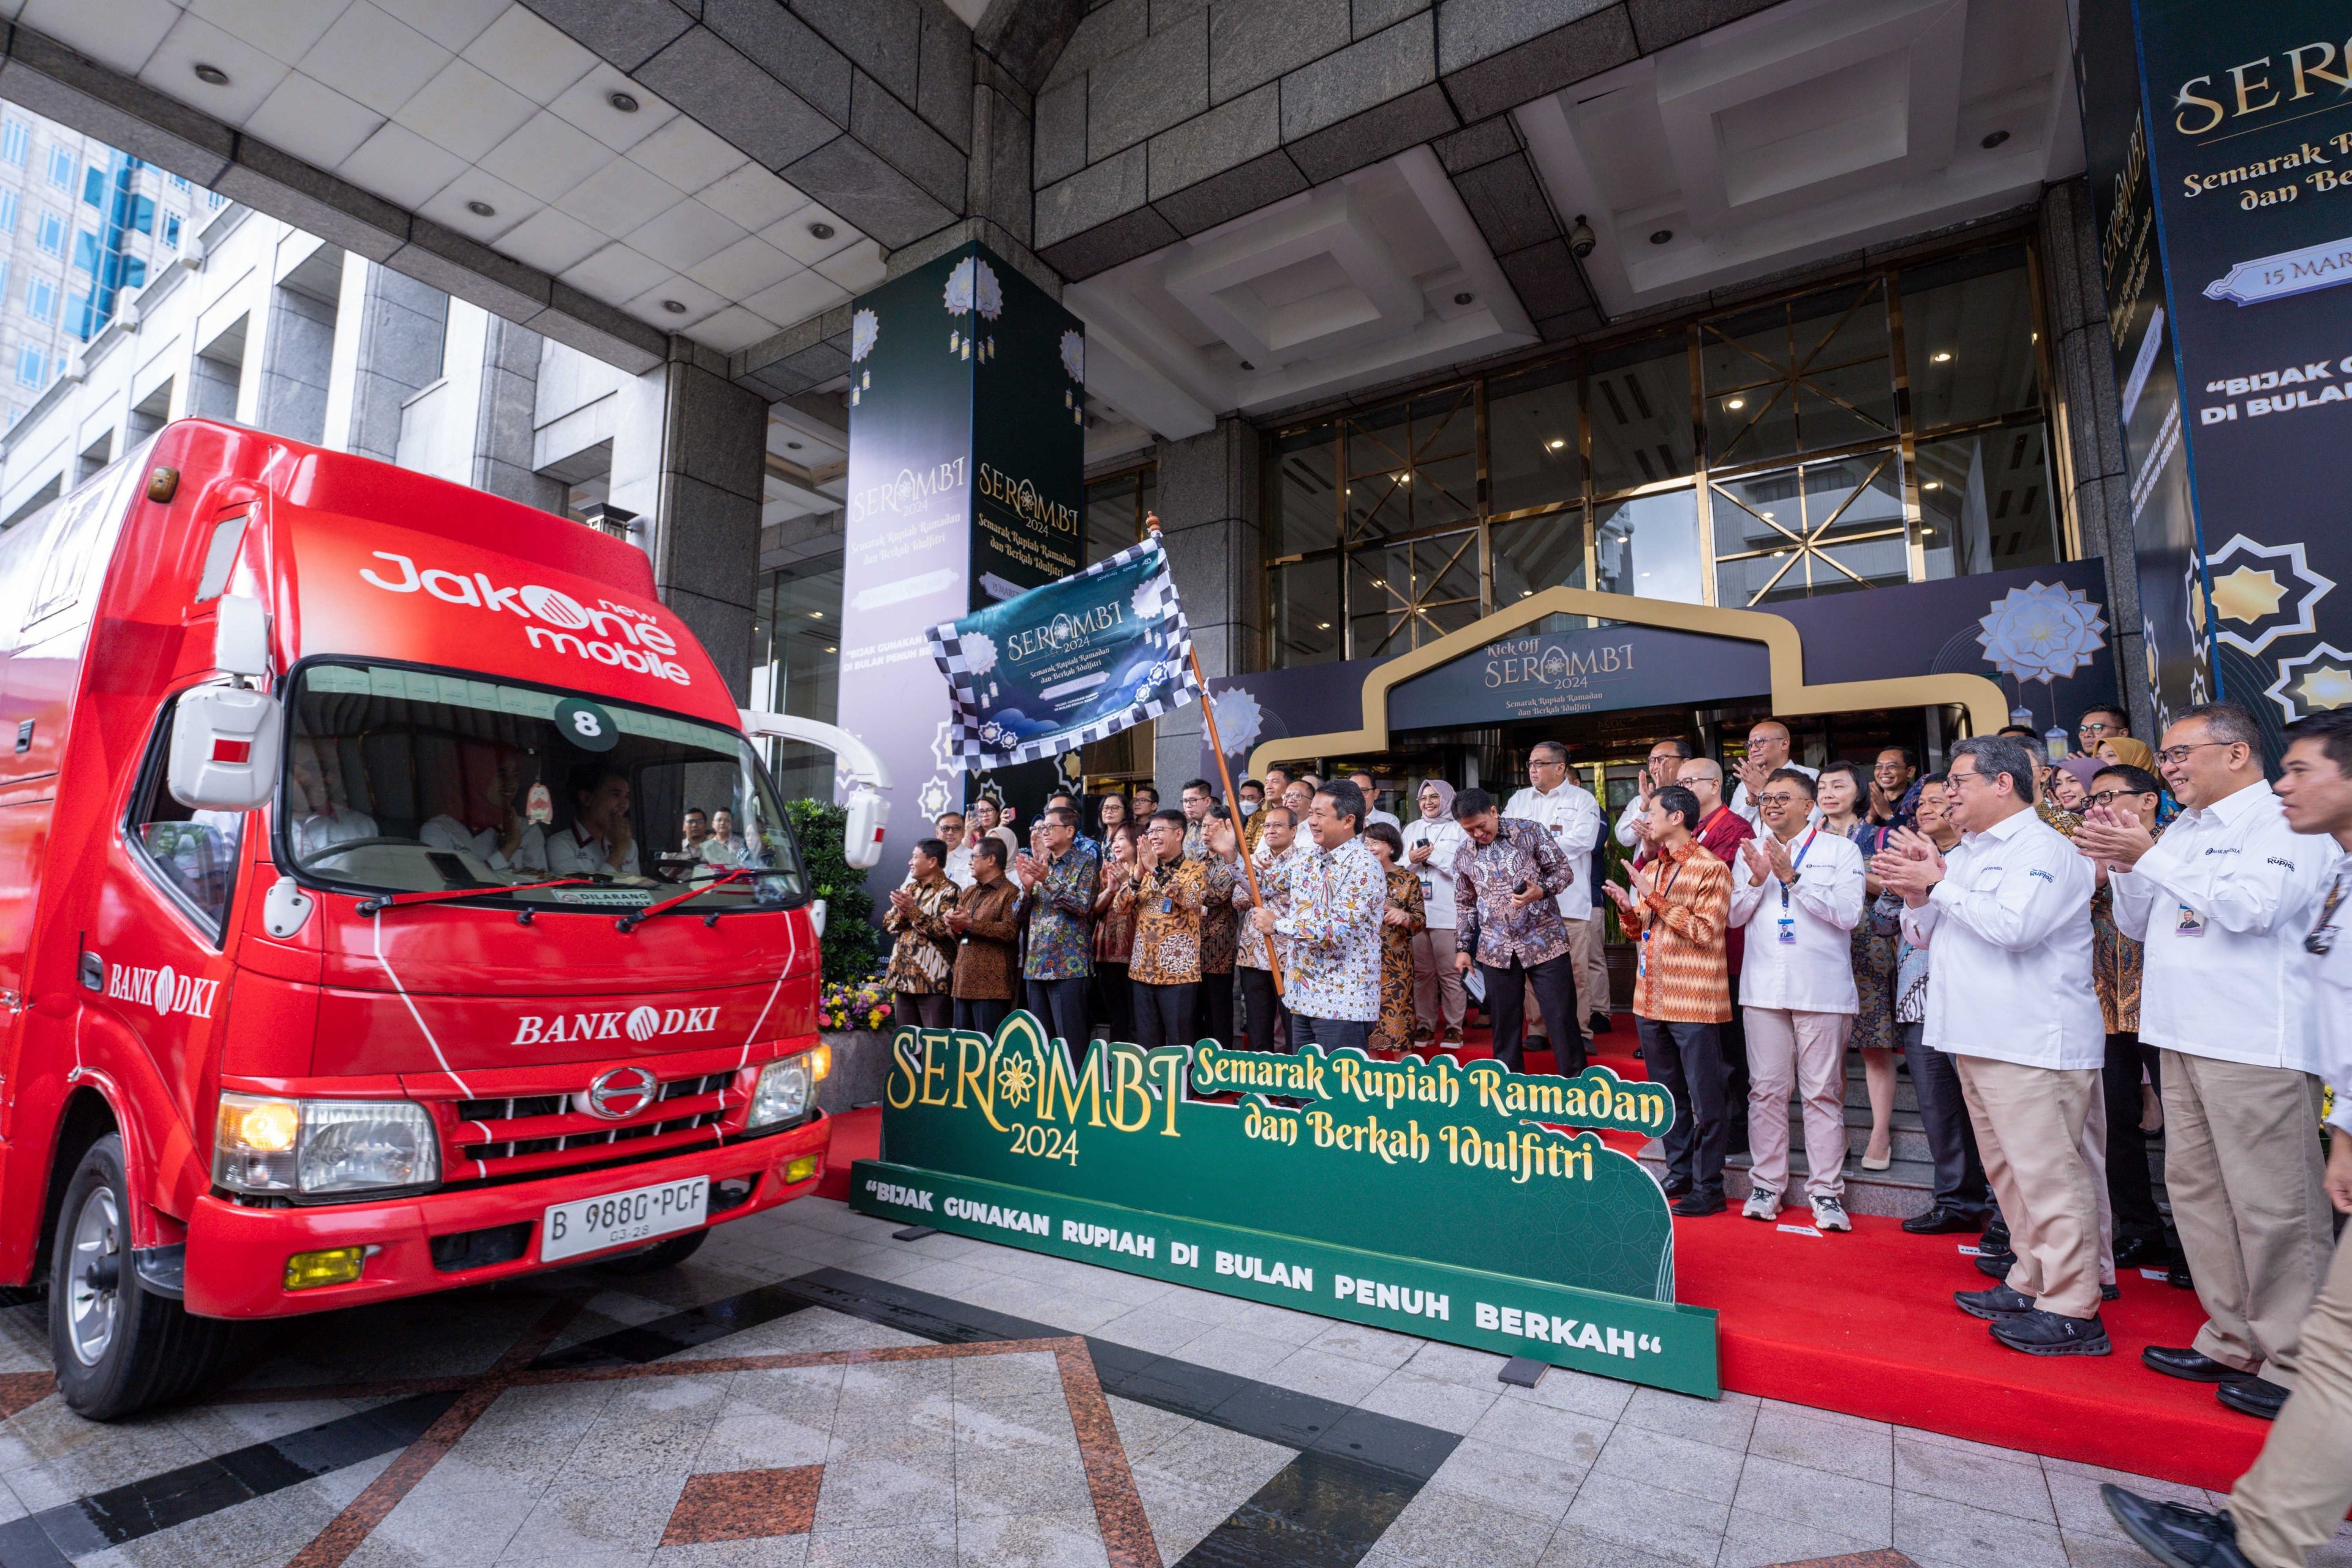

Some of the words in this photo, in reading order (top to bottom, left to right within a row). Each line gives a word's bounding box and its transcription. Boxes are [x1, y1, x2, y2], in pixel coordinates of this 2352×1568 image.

[2176, 37, 2352, 135] SER
[2184, 143, 2332, 198] Semarak
[2240, 185, 2297, 211] dan
[2264, 269, 2284, 285] 15
[2200, 403, 2237, 426] DI
[903, 499, 928, 516] 2024
[1026, 516, 1049, 538] 2024
[979, 513, 1011, 542] Semarak
[1011, 530, 1039, 552] Rupiah
[1040, 544, 1076, 568] Ramadan
[990, 535, 1003, 552] dan
[1005, 543, 1033, 566] Berkah
[598, 598, 657, 625] new
[526, 626, 690, 686] mobile
[878, 635, 922, 653] GUNAKAN
[1063, 636, 1090, 653] 2024
[1484, 643, 1517, 658] Kick
[1519, 638, 1540, 654] Off
[843, 663, 853, 672] DI
[855, 657, 884, 669] BULAN
[886, 649, 916, 662] PENUH
[1030, 665, 1056, 679] Semarak
[1056, 657, 1078, 669] Rupiah
[1079, 647, 1110, 661] Ramadan
[1052, 668, 1075, 680] Berkah
[1554, 676, 1588, 690] 2024
[1506, 698, 1537, 709] Semarak
[1538, 695, 1565, 704] Rupiah
[1566, 692, 1602, 702] Ramadan
[1532, 706, 1559, 715] Berkah
[574, 710, 602, 736] 8
[108, 963, 158, 1006] BANK
[172, 974, 220, 1019] DKI
[511, 1012, 625, 1045] BANK
[659, 1006, 721, 1036] DKI
[1197, 1047, 1333, 1100] Semarak
[1332, 1057, 1460, 1110] Rupiah
[1469, 1069, 1665, 1128] Ramadan
[1009, 1123, 1079, 1167] 2024
[1244, 1099, 1298, 1146] dan
[1306, 1110, 1430, 1164] Berkah
[1439, 1126, 1594, 1184] Idulfitri
[552, 1211, 567, 1240] B
[944, 1197, 1049, 1237] GUNAKAN
[1062, 1221, 1155, 1259] RUPIAH
[1170, 1242, 1198, 1269] DI
[1215, 1251, 1313, 1291] BULAN
[1335, 1274, 1449, 1321] PENUH
